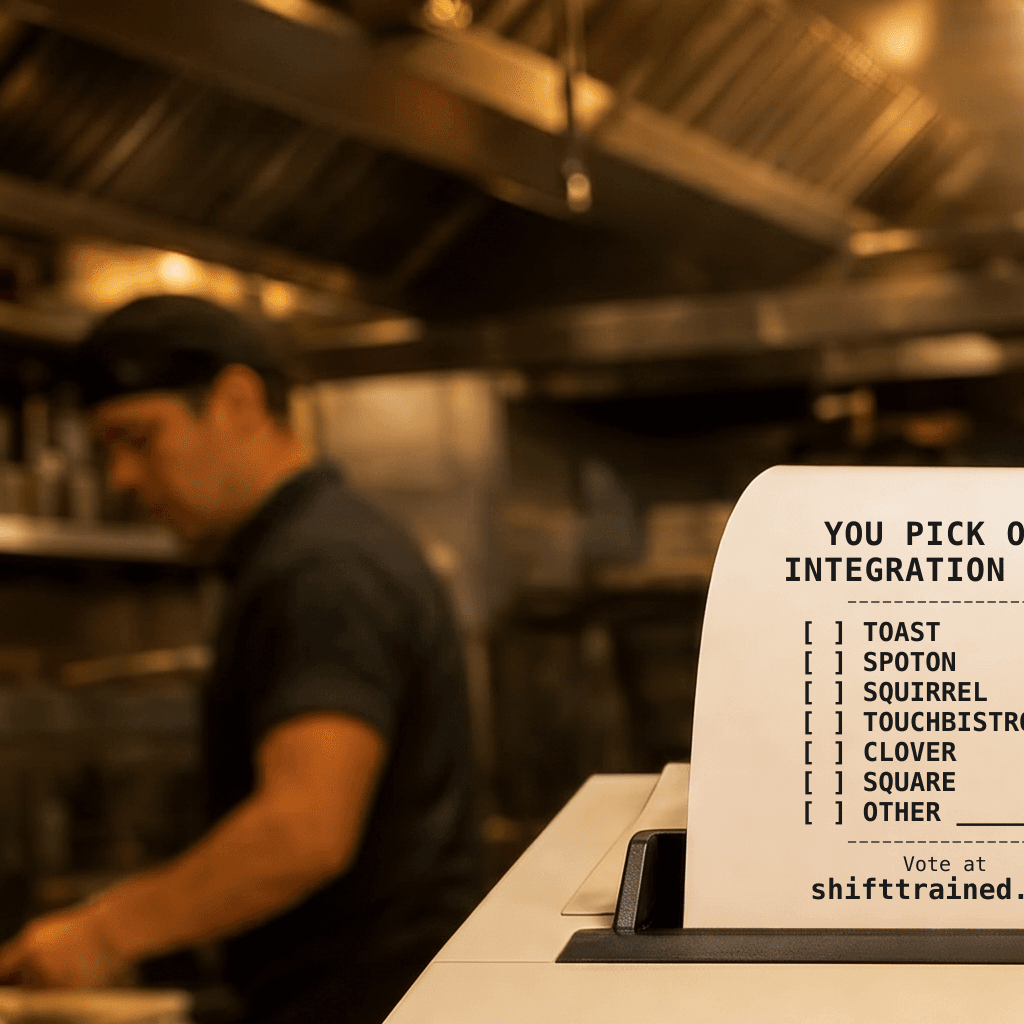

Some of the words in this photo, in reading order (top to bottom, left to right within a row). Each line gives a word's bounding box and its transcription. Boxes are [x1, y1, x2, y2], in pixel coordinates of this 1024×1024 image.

[823, 520, 883, 547] YOU
[906, 520, 986, 547] PICK
[785, 556, 1005, 583] INTEGRATION
[863, 621, 941, 642] TOAST
[863, 651, 956, 672] SPOTON
[863, 681, 988, 705] SQUIRREL
[863, 741, 957, 762] CLOVER
[863, 771, 956, 795] SQUARE
[863, 801, 942, 822] OTHER
[903, 855, 951, 872] Vote
[963, 856, 986, 872] at
